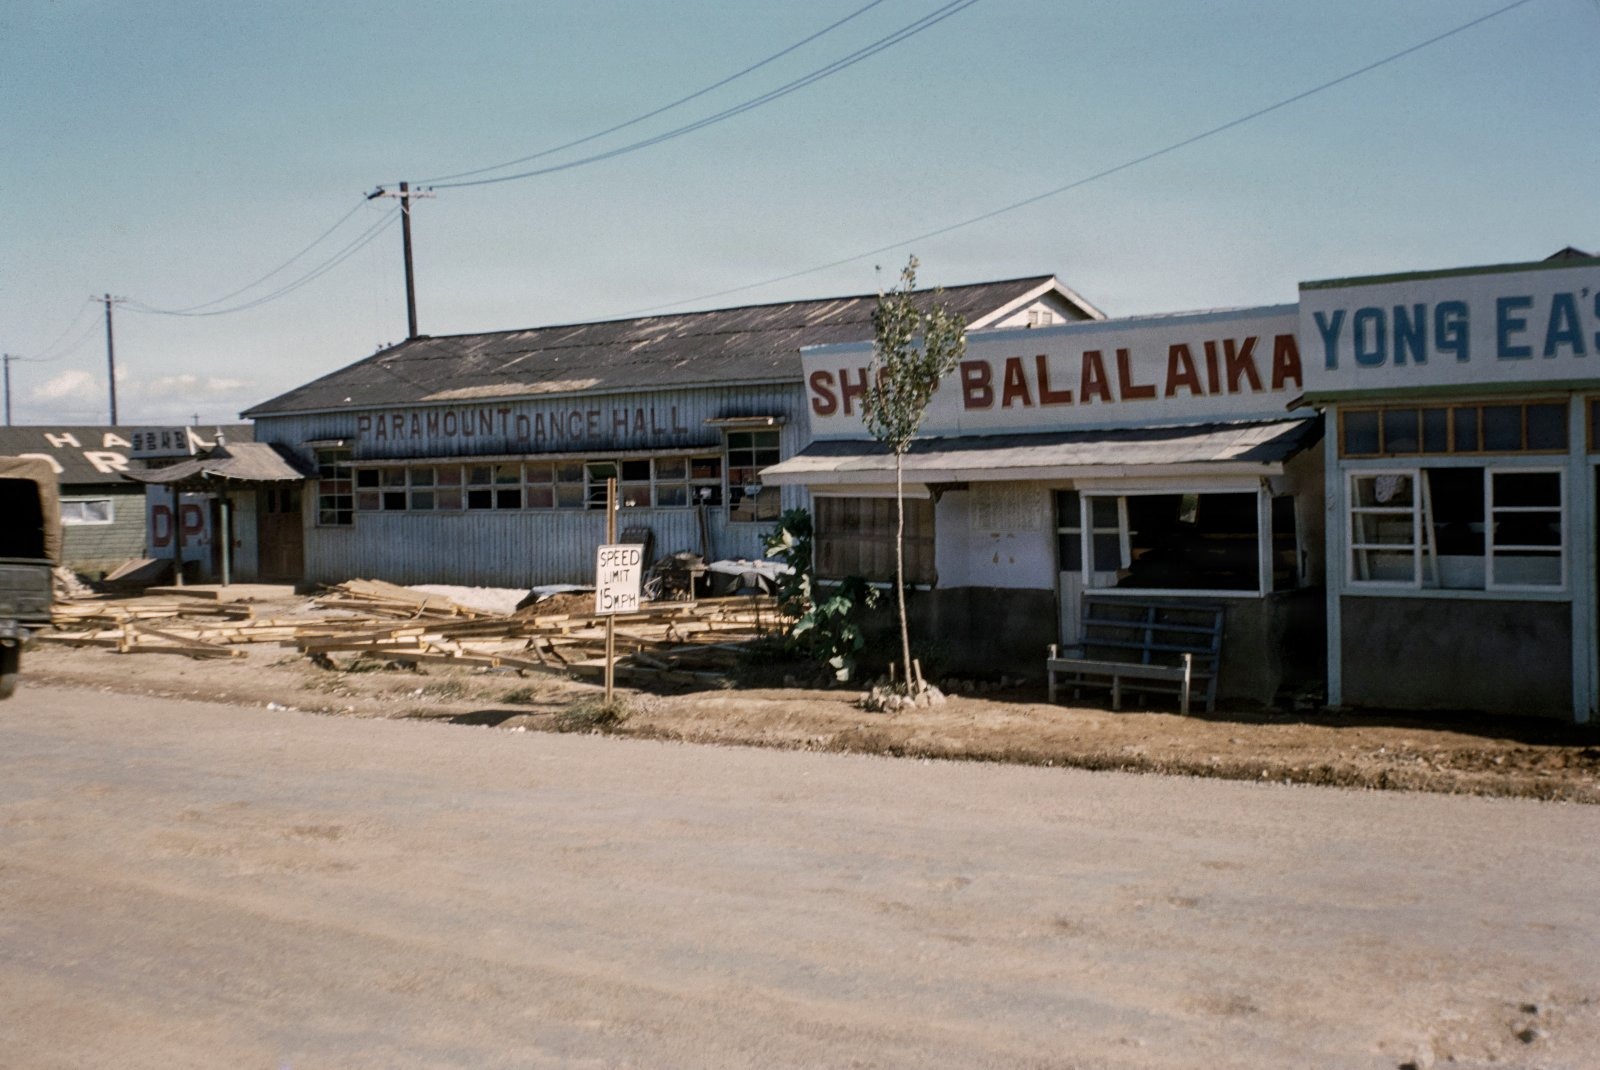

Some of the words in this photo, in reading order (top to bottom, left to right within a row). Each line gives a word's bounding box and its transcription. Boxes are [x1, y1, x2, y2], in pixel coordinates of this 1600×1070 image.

[1313, 300, 1470, 371] YONG
[1496, 287, 1600, 361] EA'
[809, 366, 940, 417] SH
[960, 333, 1304, 411] BALALAIKA
[357, 408, 512, 440] PARAMOUNT
[516, 410, 601, 443] DANCE
[612, 406, 688, 439] HALL
[600, 549, 640, 567] SPEED
[604, 568, 630, 584] LIMIT
